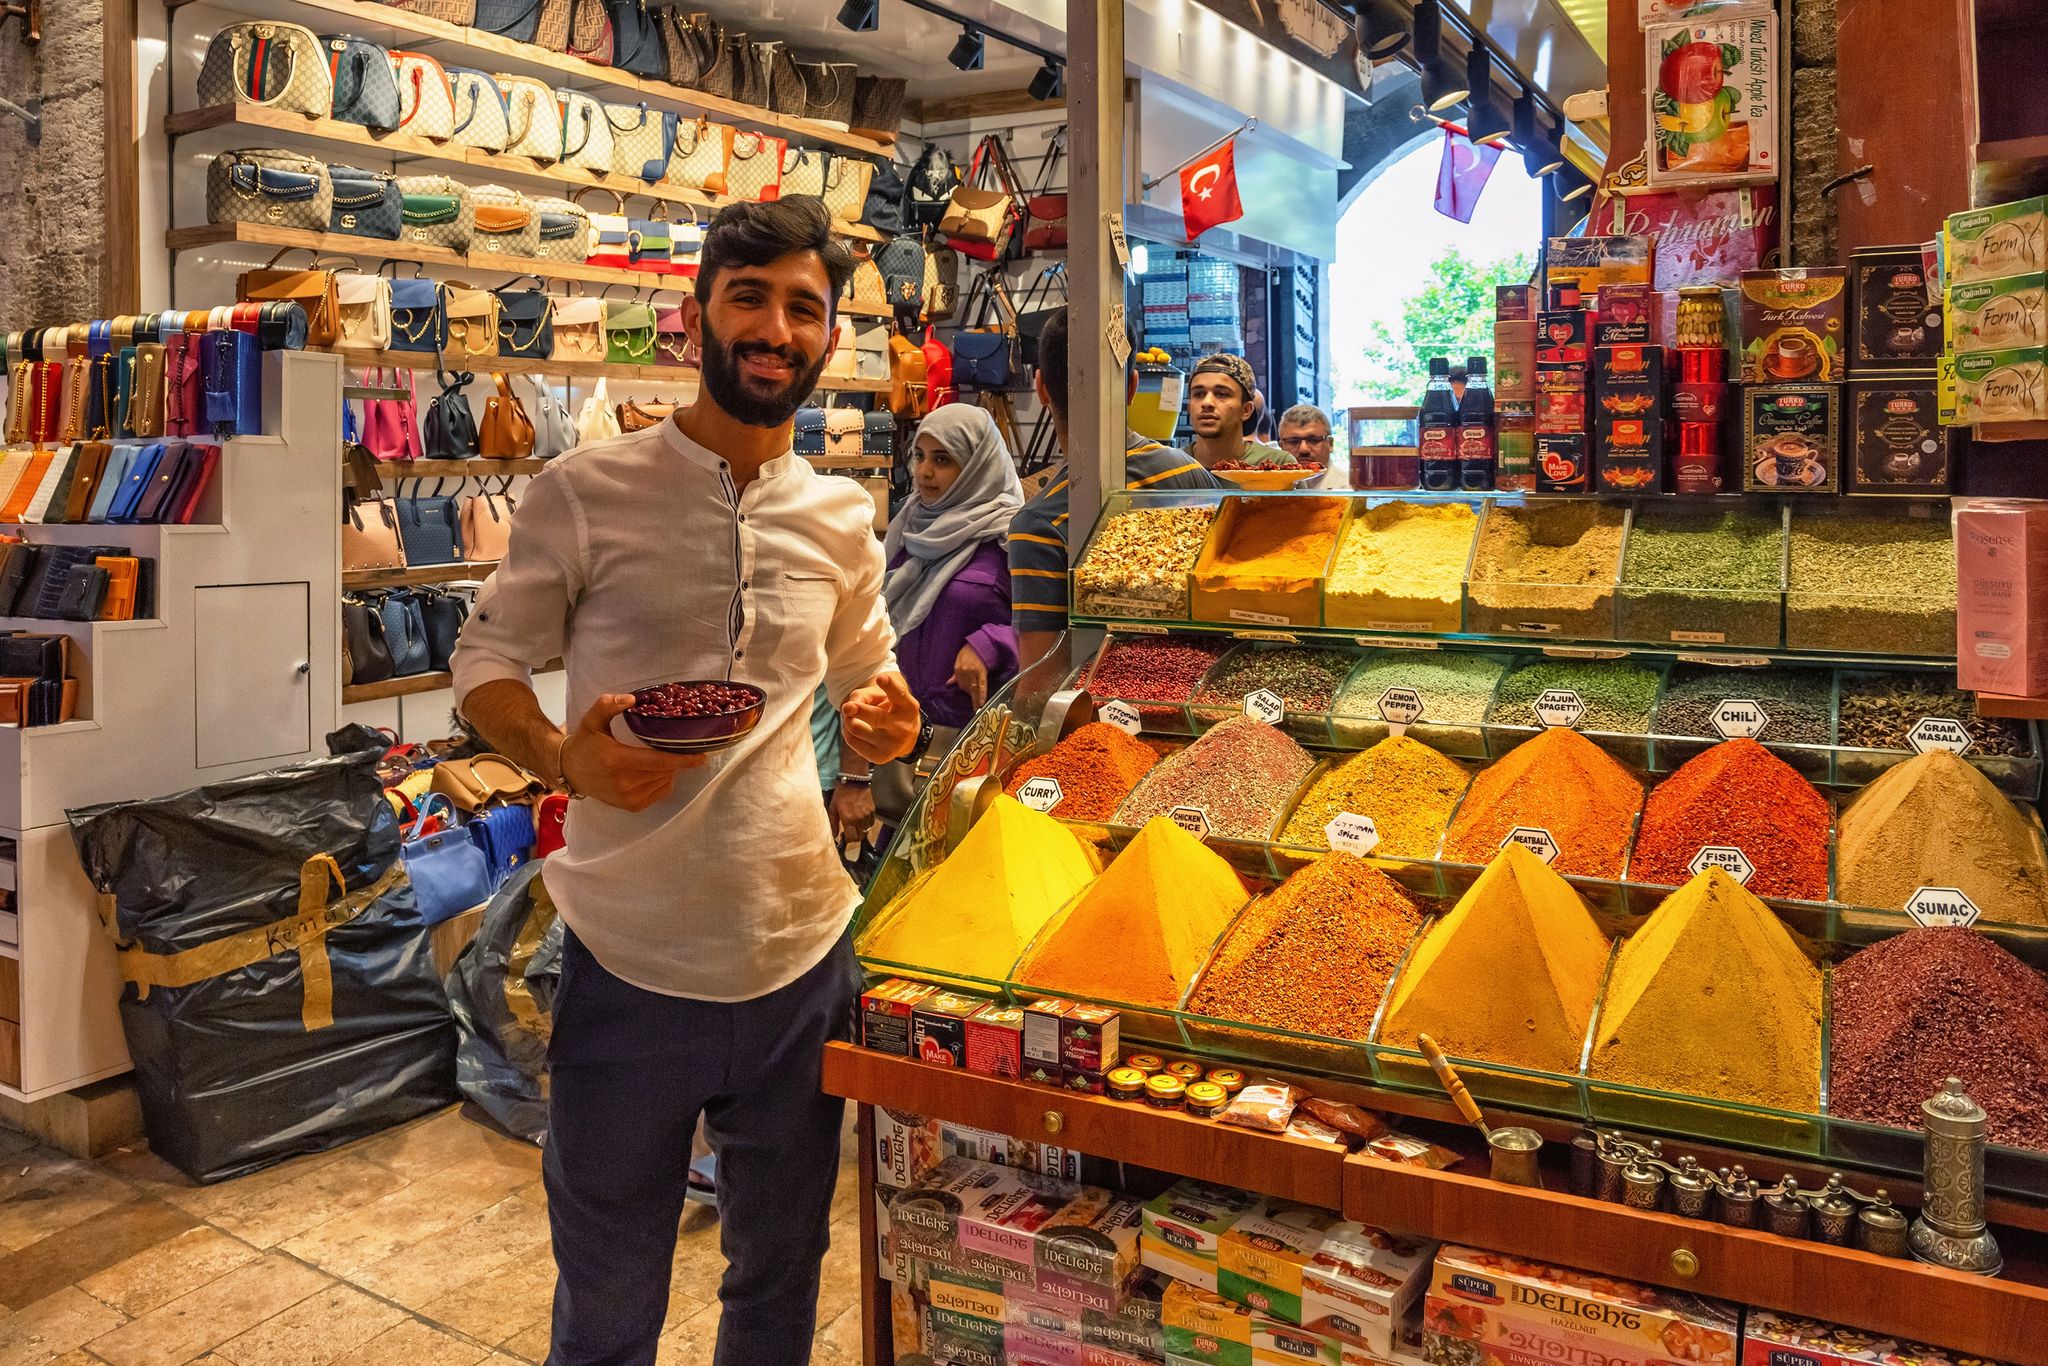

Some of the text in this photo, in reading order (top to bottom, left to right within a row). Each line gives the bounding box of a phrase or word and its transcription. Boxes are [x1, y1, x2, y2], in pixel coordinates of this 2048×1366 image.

[1738, 21, 1746, 38] Elma
[1745, 19, 1768, 119] Mixed Turkish Apple Tea
[1983, 236, 2018, 258] Form
[1984, 307, 2020, 329] Form
[1985, 379, 2020, 400] Form
[1758, 412, 1824, 430] Ottoman Coffee
[1549, 463, 1568, 471] MAKE
[1257, 693, 1280, 711] SALAD
[1385, 700, 1417, 711] PEPPER
[1389, 693, 1415, 702] LEMON
[1544, 695, 1575, 703] CAJUN
[1107, 706, 1139, 722] OTTOMAN
[1538, 703, 1580, 712] SPAGETTI
[1917, 732, 1963, 743] MASALA
[1923, 724, 1957, 733] GRAM
[1024, 787, 1057, 799] CURRY
[1513, 835, 1548, 846] MEATBALL
[1916, 902, 1969, 917] SUMAC
[926, 1048, 947, 1061] MAKE
[892, 1123, 907, 1185] DELIGHT
[901, 1210, 950, 1232] DELIGHT
[970, 1225, 1028, 1250] DELIGHT
[1252, 1223, 1305, 1246] Banana
[900, 1239, 948, 1261] DELIGHT
[971, 1258, 1023, 1282] DELIGHT
[1050, 1250, 1104, 1274] DELIGHT
[1457, 1276, 1490, 1292] SÜPER
[1042, 1281, 1104, 1308] DELIGHT
[937, 1293, 993, 1315] DELIGHT
[1521, 1287, 1641, 1330] DELIGHT
[941, 1312, 998, 1336] DELIGHT
[1550, 1317, 1598, 1336] HAZELNUT
[1094, 1326, 1149, 1347] DELIGHT
[1195, 1337, 1219, 1350] TURKO
[943, 1342, 993, 1366] DELIGHT
[1776, 1353, 1814, 1366] SÜPER
